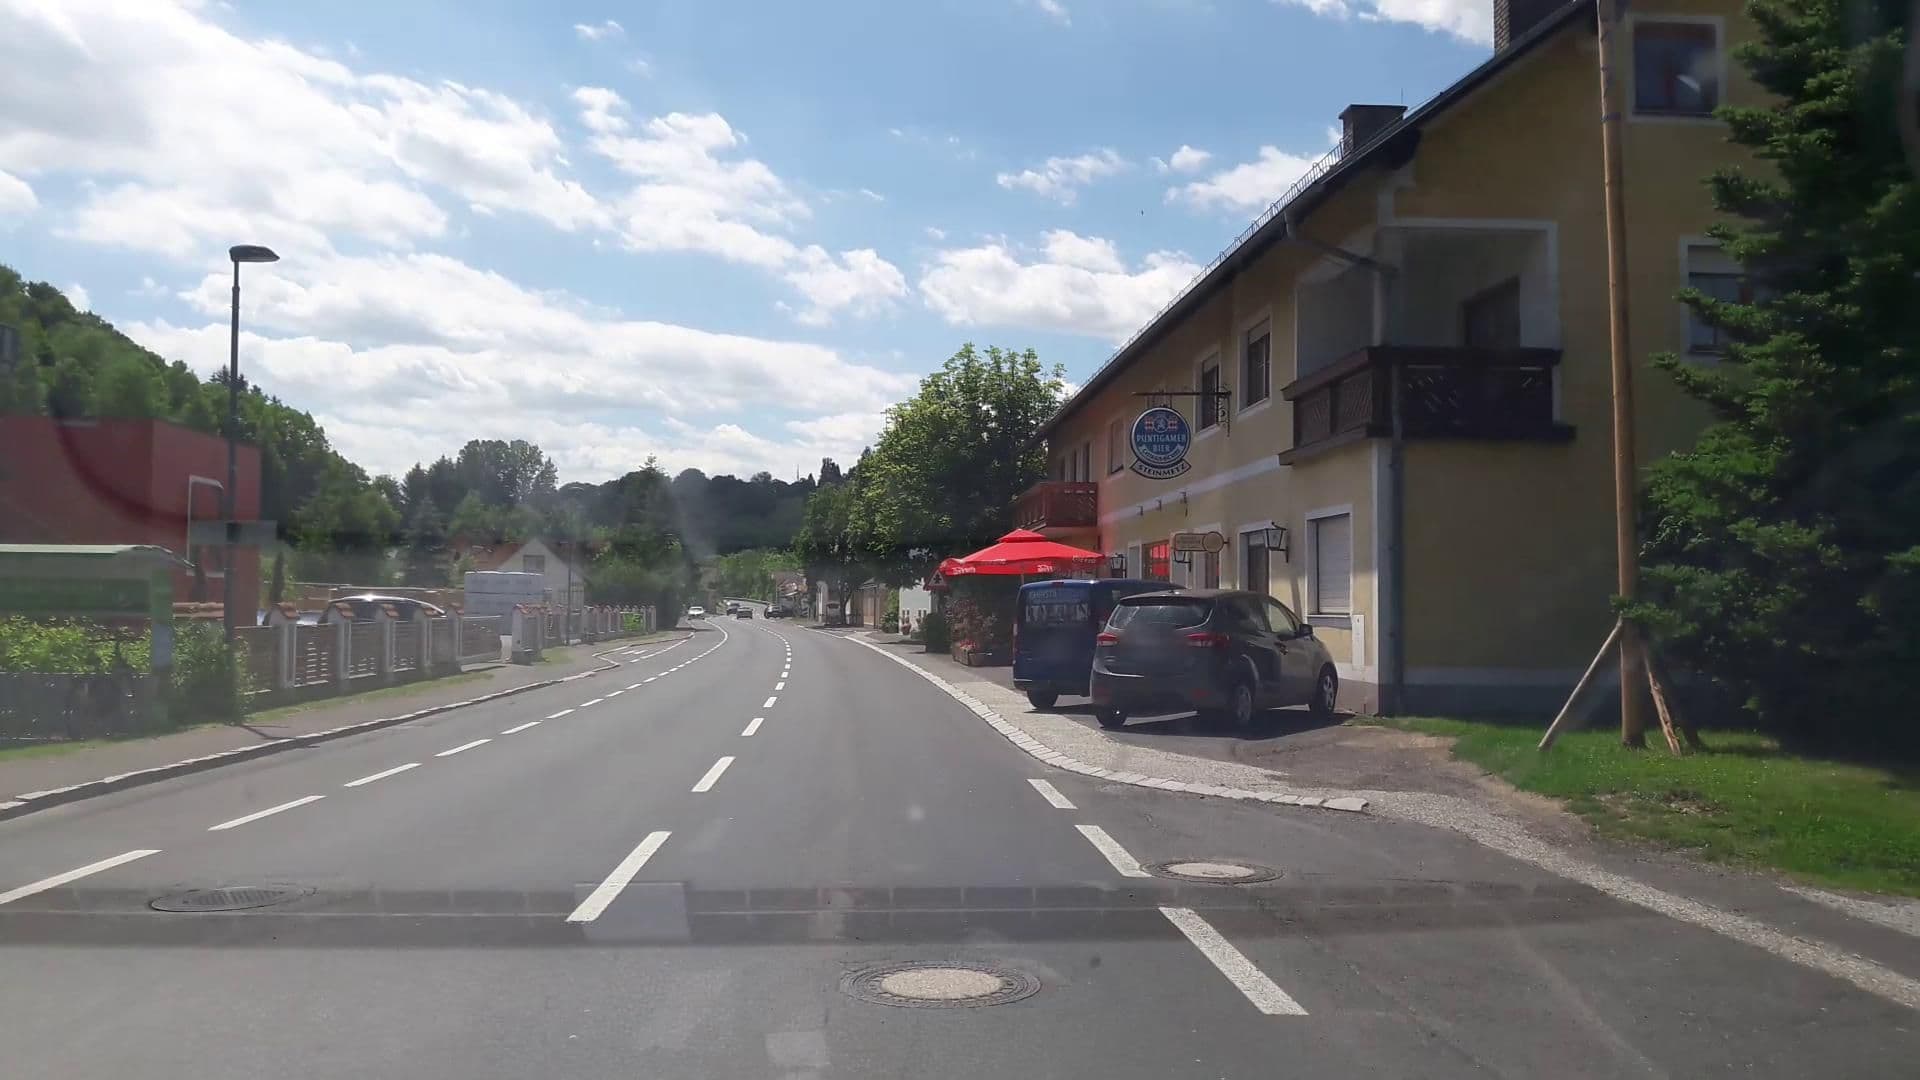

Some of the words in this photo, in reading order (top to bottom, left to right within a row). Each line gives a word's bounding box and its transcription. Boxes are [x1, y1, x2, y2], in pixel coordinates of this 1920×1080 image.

[1136, 434, 1186, 443] PUNTIGAMER
[1152, 444, 1171, 452] BIER
[1137, 463, 1186, 477] STEINMETZ
